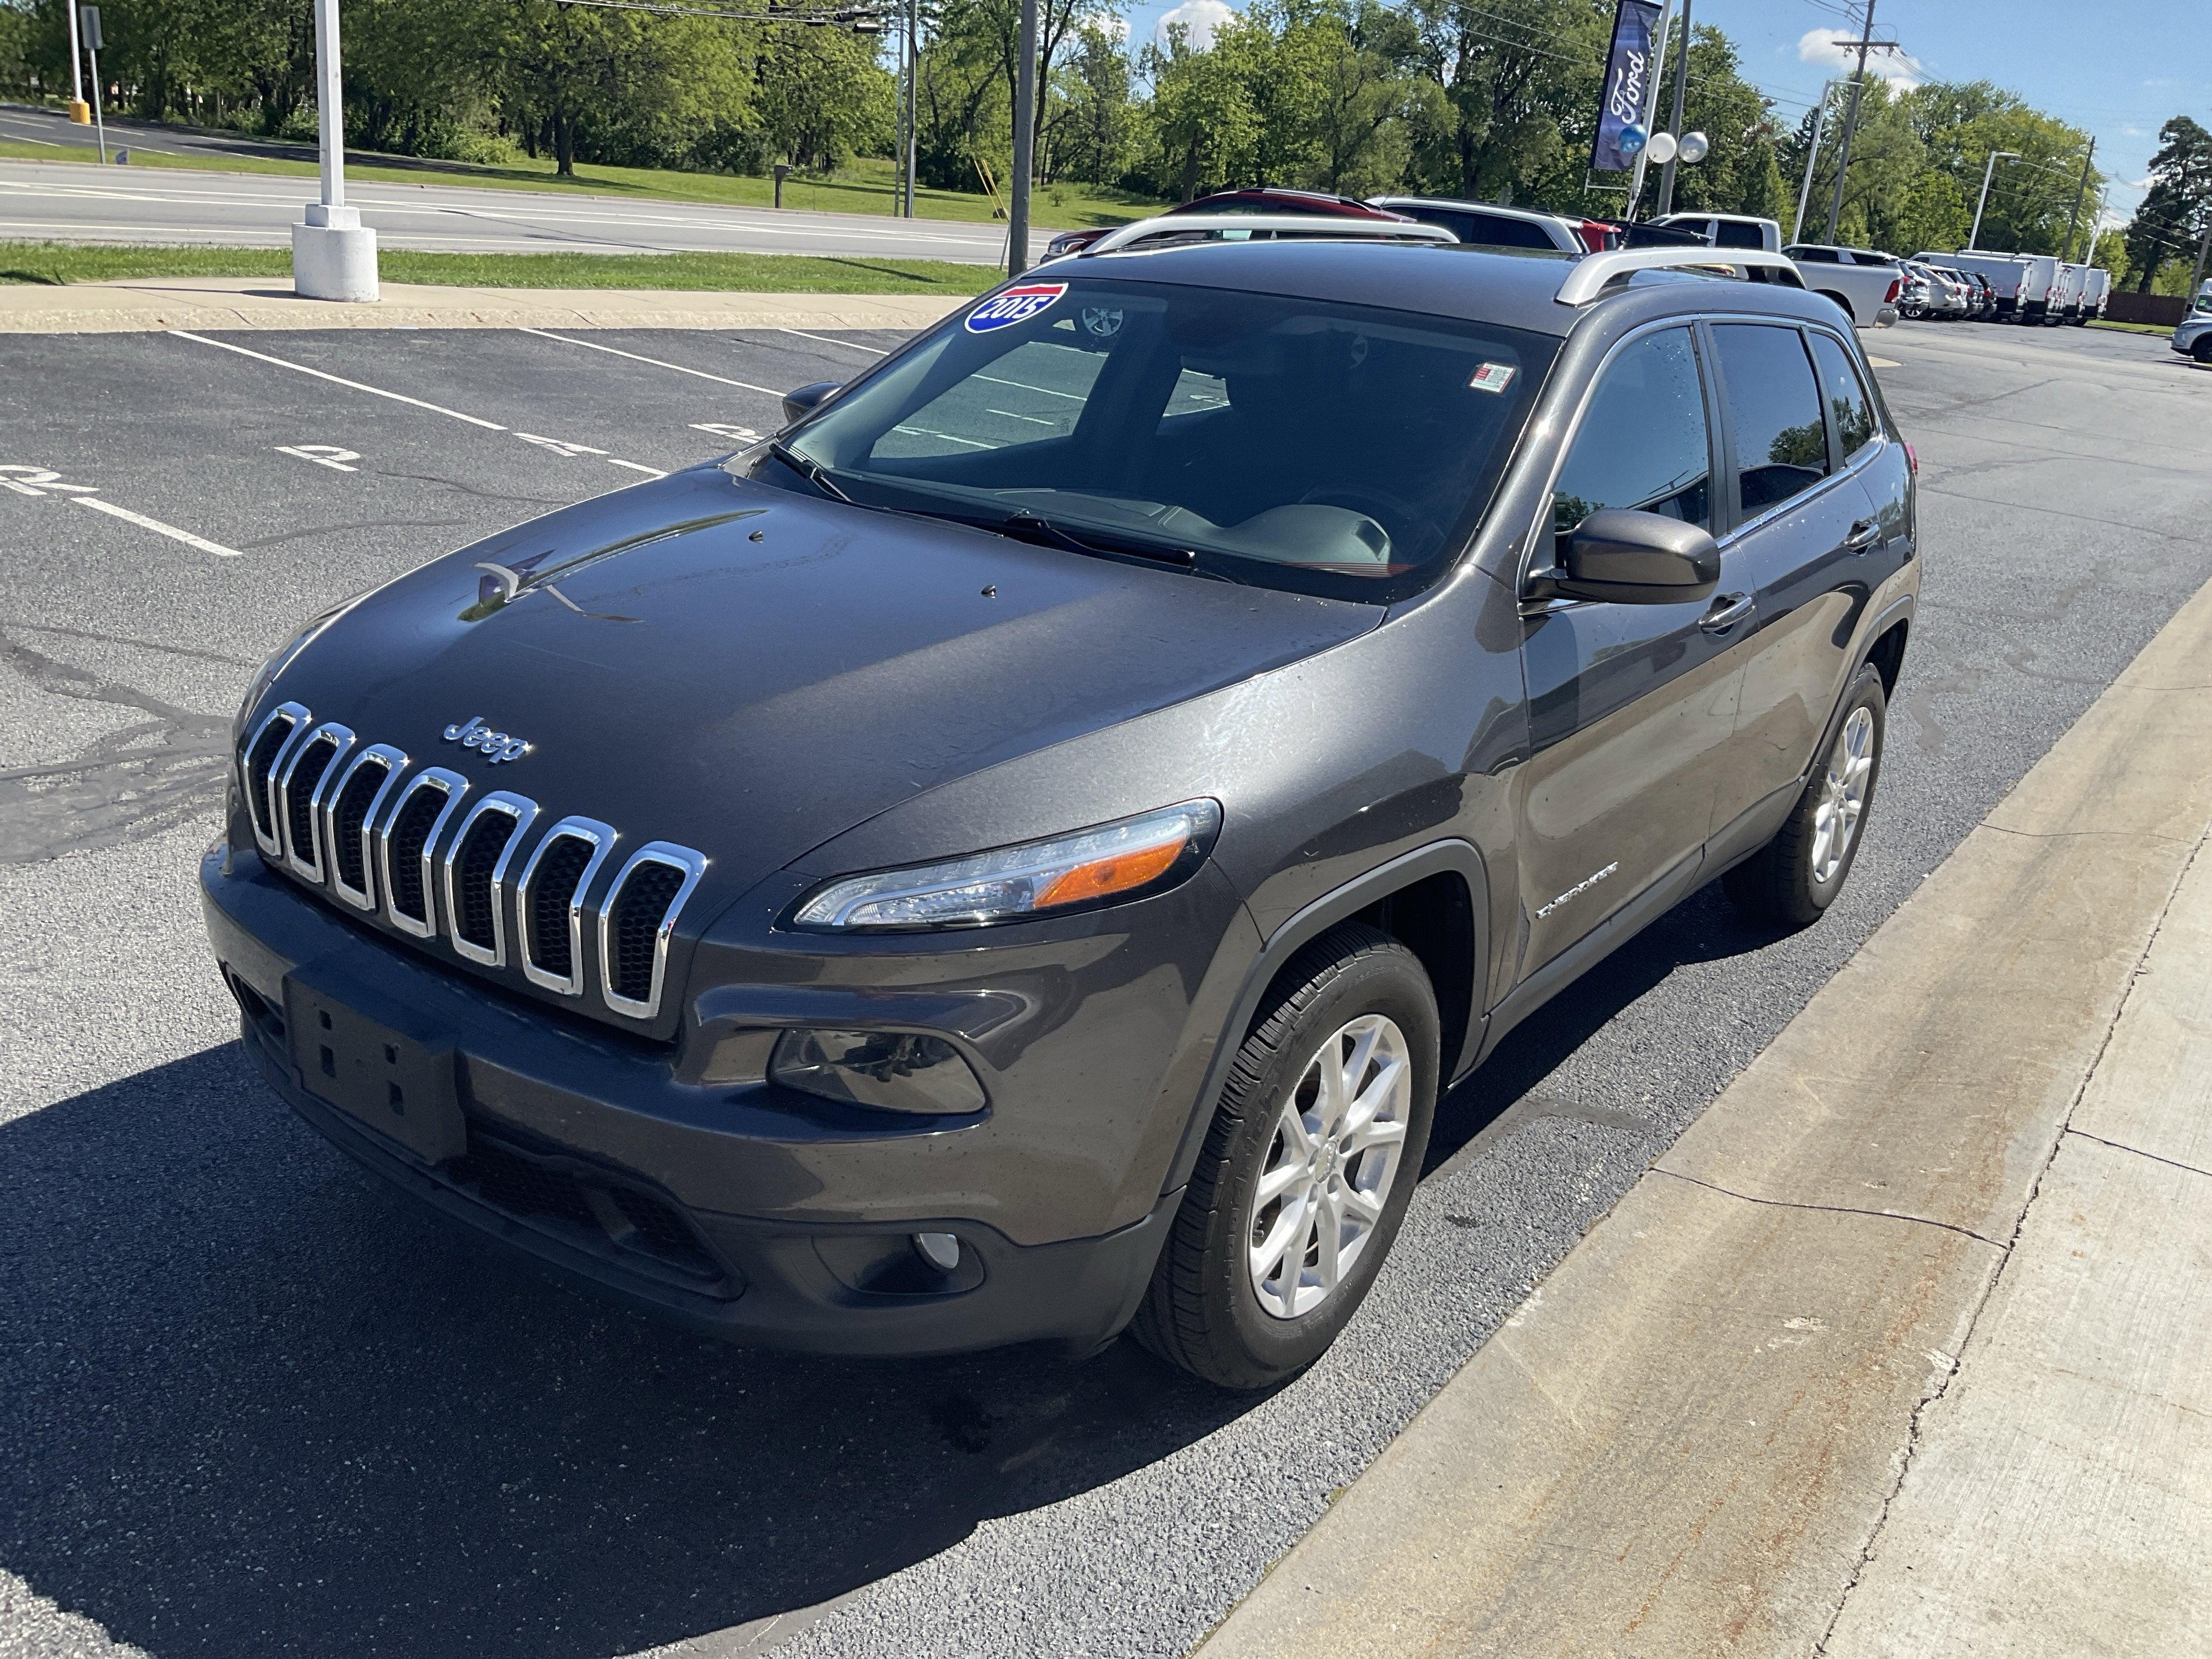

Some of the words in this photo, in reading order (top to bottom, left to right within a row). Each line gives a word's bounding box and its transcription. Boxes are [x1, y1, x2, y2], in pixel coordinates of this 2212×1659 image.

[1611, 50, 1645, 125] Ford
[972, 296, 1051, 319] 2015
[274, 445, 360, 471] P
[443, 716, 532, 764] Jeep
[1536, 861, 1618, 919] CHEROKEE
